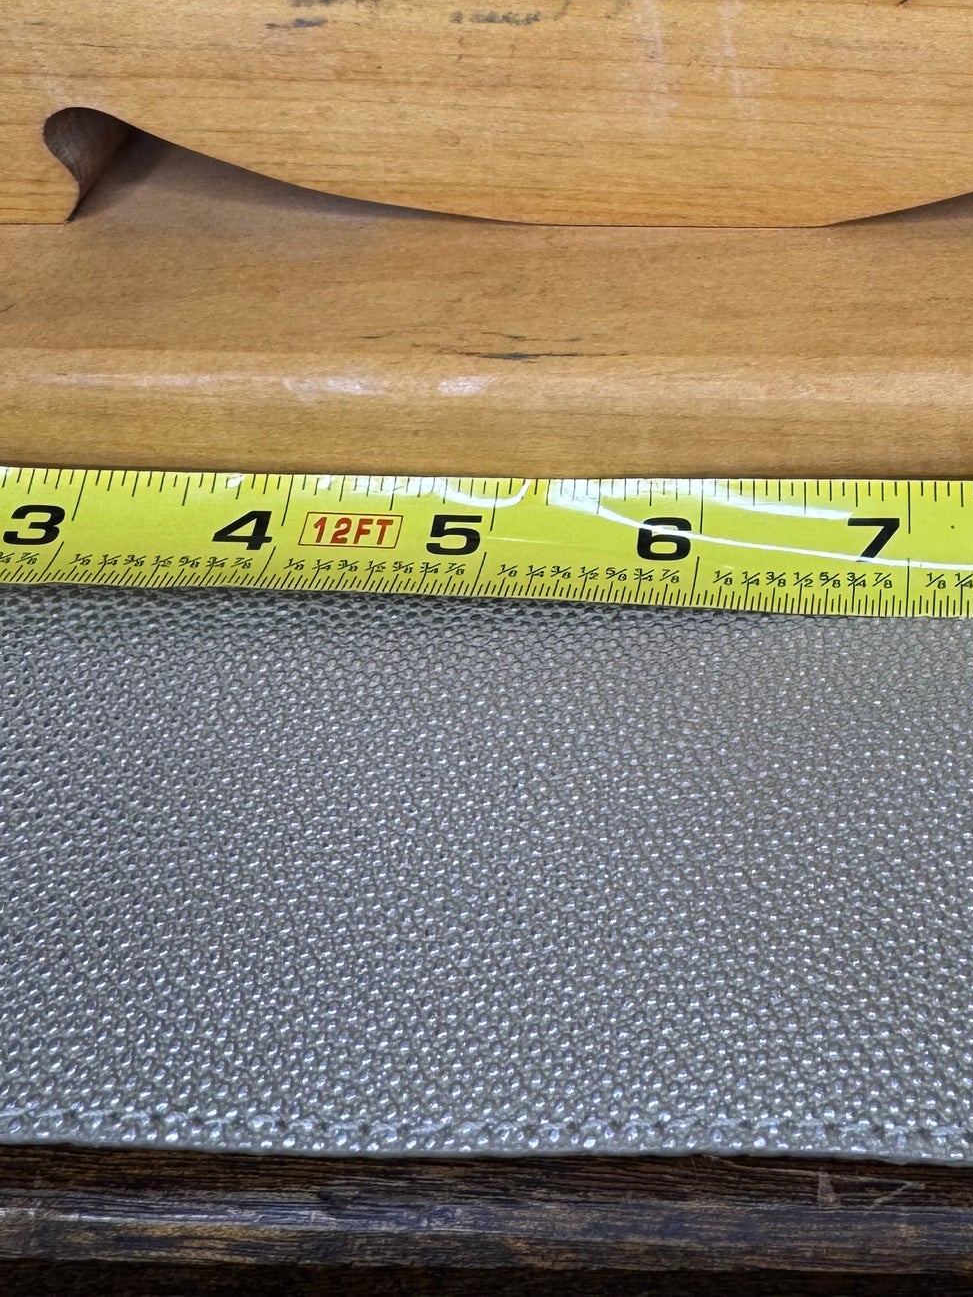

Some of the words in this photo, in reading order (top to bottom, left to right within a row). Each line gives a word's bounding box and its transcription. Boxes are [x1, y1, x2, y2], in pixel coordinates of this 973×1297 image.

[3, 505, 65, 545] 3
[212, 510, 272, 550] 4
[313, 517, 394, 545] 12FT
[426, 514, 483, 555] 5
[636, 517, 692, 561] 6
[847, 518, 900, 562] 7
[712, 570, 733, 586] 1/8
[741, 571, 761, 586] 1/4
[766, 571, 787, 587] 3/8
[793, 572, 814, 588] 1/2
[819, 572, 841, 588] 5/8
[846, 572, 867, 588] 3/4
[872, 572, 893, 589] 7/8
[925, 573, 947, 589] 1/8
[954, 573, 973, 589] 1/4
